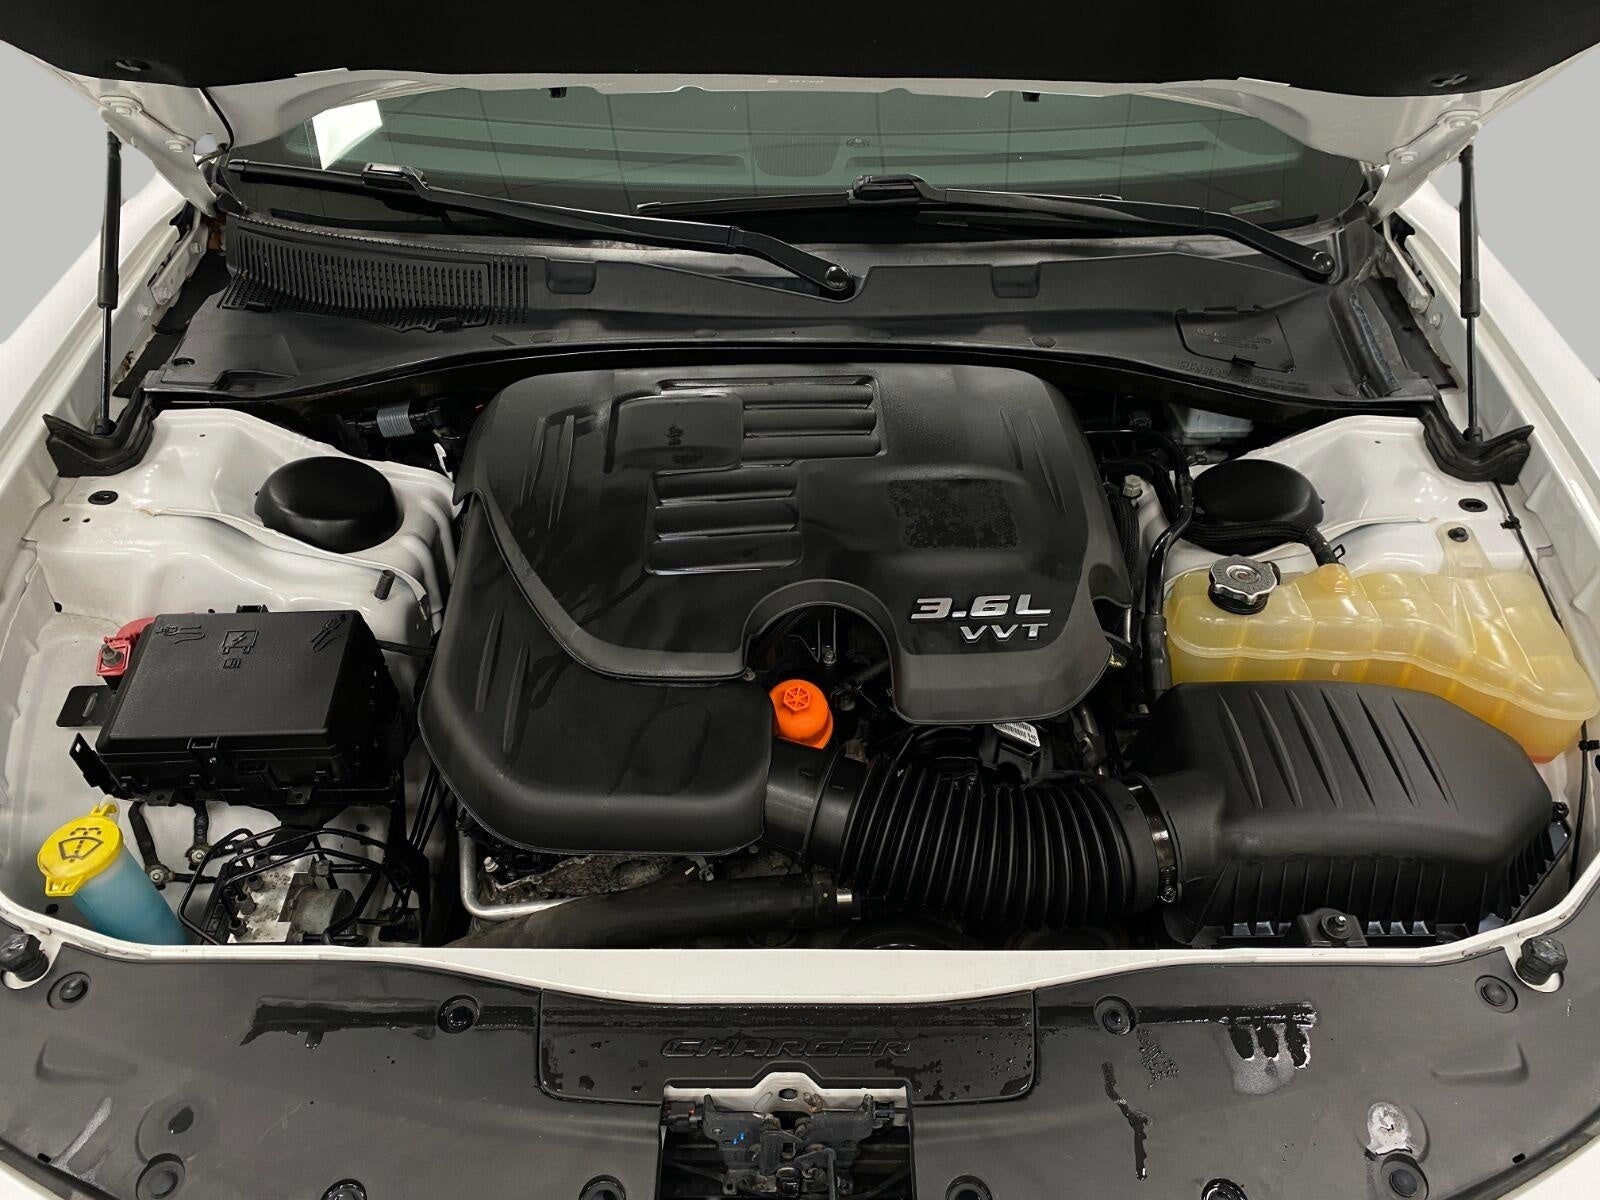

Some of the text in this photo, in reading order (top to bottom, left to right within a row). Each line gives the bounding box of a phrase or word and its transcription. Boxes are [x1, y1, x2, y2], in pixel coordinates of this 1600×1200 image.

[911, 594, 1051, 620] 3.6L
[960, 623, 1049, 642] VVT
[661, 1039, 911, 1058] CHARGER
